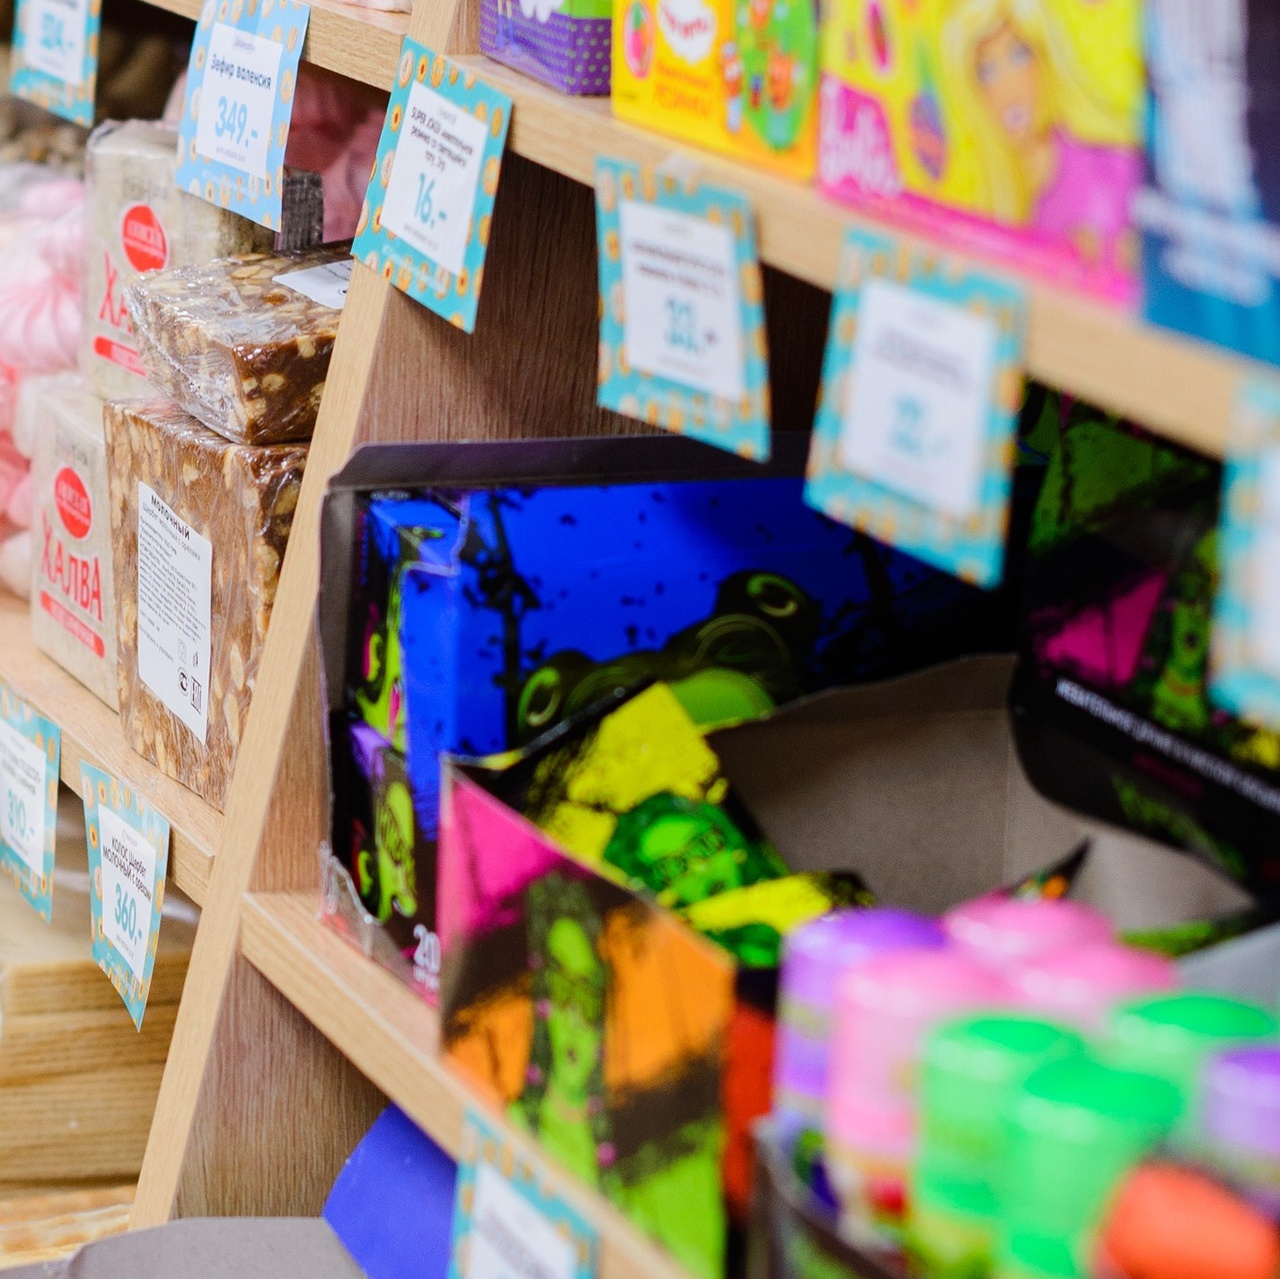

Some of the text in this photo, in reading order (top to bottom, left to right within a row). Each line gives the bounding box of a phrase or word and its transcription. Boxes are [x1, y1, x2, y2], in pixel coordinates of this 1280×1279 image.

[211, 52, 272, 91] Зефир валенсия
[214, 95, 259, 149] 349.-
[415, 174, 446, 228] 16.-
[151, 494, 190, 541] МОЛОЧНЫЙ
[40, 508, 104, 623] ХАЛВА
[115, 883, 143, 946] 360.-
